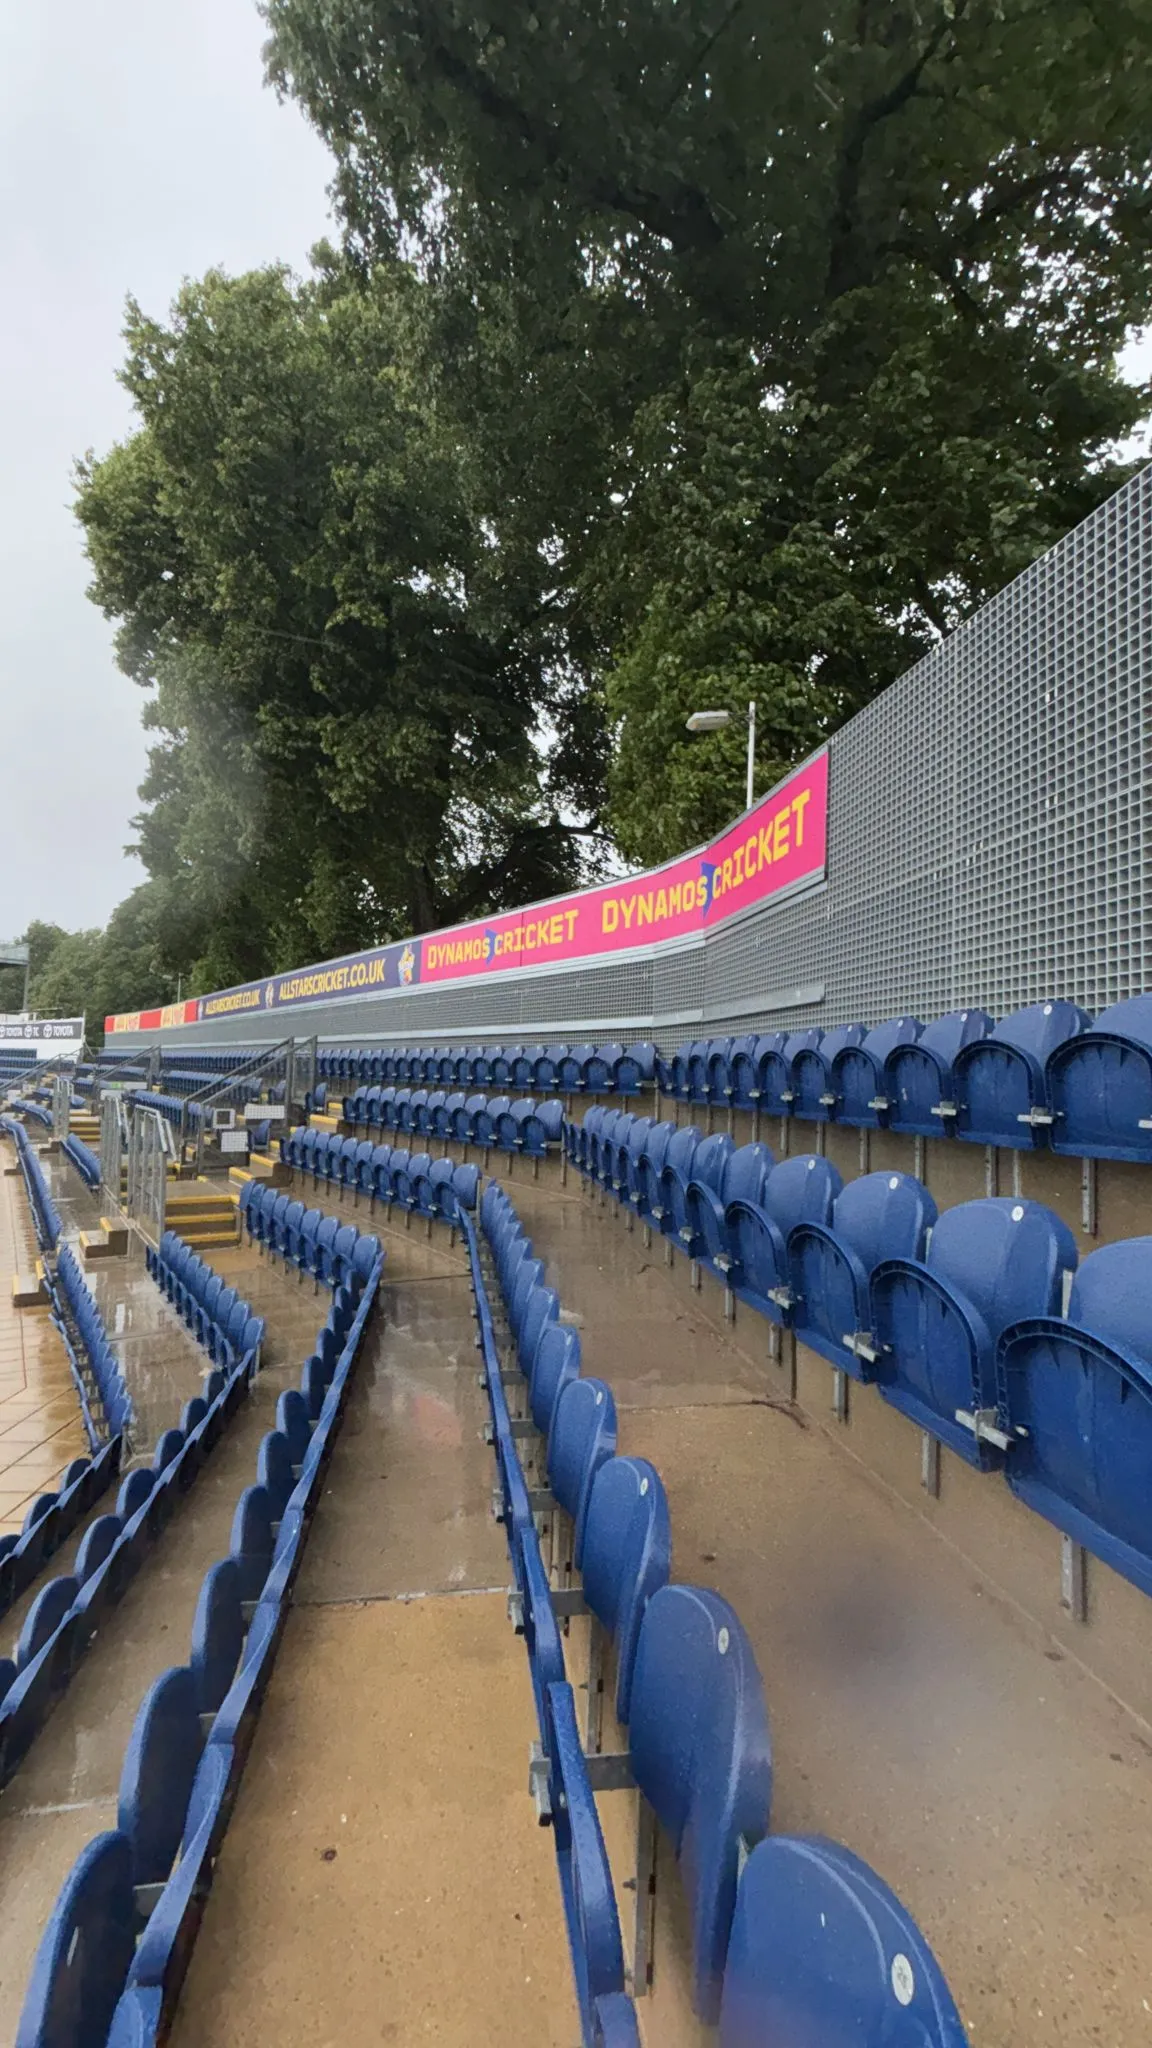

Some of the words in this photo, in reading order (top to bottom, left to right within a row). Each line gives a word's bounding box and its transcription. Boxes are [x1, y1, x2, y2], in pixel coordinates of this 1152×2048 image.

[602, 875, 707, 933] DYNAMOS
[712, 789, 811, 899] CRICKET
[427, 937, 490, 969] DYNAMOS
[494, 909, 579, 955] CRICKET
[279, 958, 385, 1000] ALLSTARSCRICKET.CO.UK
[53, 1025, 74, 1036] TOYOTA
